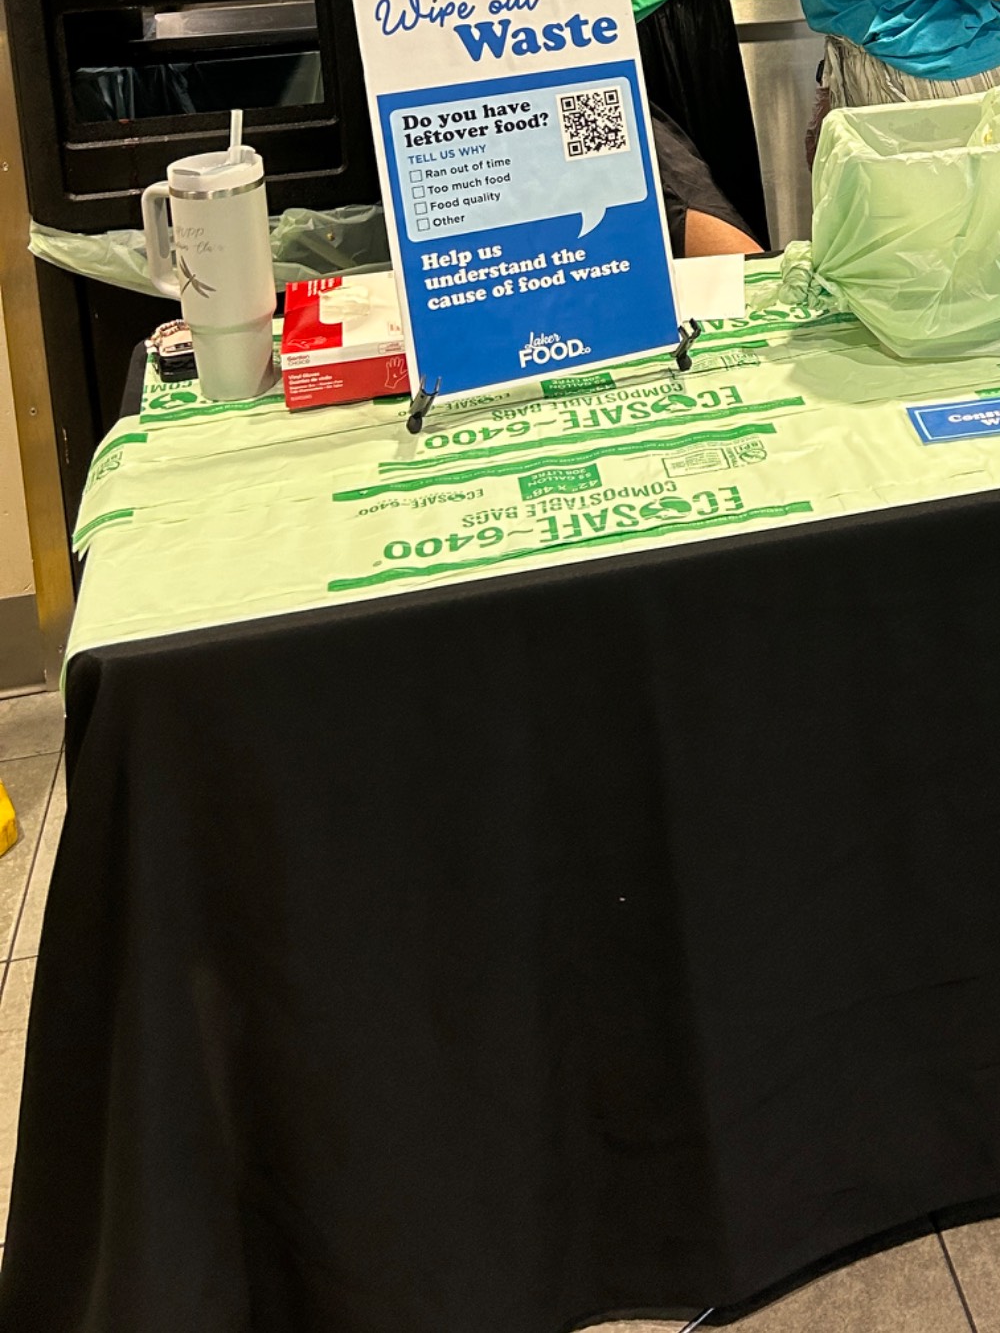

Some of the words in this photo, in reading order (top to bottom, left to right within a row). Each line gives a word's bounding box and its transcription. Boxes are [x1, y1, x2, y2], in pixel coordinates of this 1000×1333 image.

[453, 13, 618, 62] Waste
[401, 114, 432, 131] Do
[437, 107, 477, 129] you
[482, 101, 531, 118] have
[404, 125, 489, 148] leftover
[494, 112, 549, 134] food?
[408, 152, 437, 165] TELL
[440, 149, 456, 160] US
[458, 144, 487, 157] WHY
[425, 169, 447, 179] Ran
[450, 165, 469, 175] out
[472, 162, 484, 172] of
[486, 157, 512, 169] time
[427, 185, 449, 195] Too
[452, 178, 482, 191] much
[485, 172, 511, 185] food
[430, 198, 460, 212] Food
[462, 191, 501, 206] quality
[432, 214, 466, 227] Other
[420, 248, 473, 271] Help
[477, 244, 503, 261] us
[424, 253, 547, 290] understand
[551, 248, 586, 266] the
[427, 288, 488, 311] cause
[491, 279, 515, 298] of
[517, 270, 566, 293] food
[569, 259, 631, 282] waste
[518, 339, 584, 368] FOOD
[525, 331, 561, 350] Laker
[525, 480, 677, 520] COMPOSTABLE
[462, 509, 520, 529] BAGS
